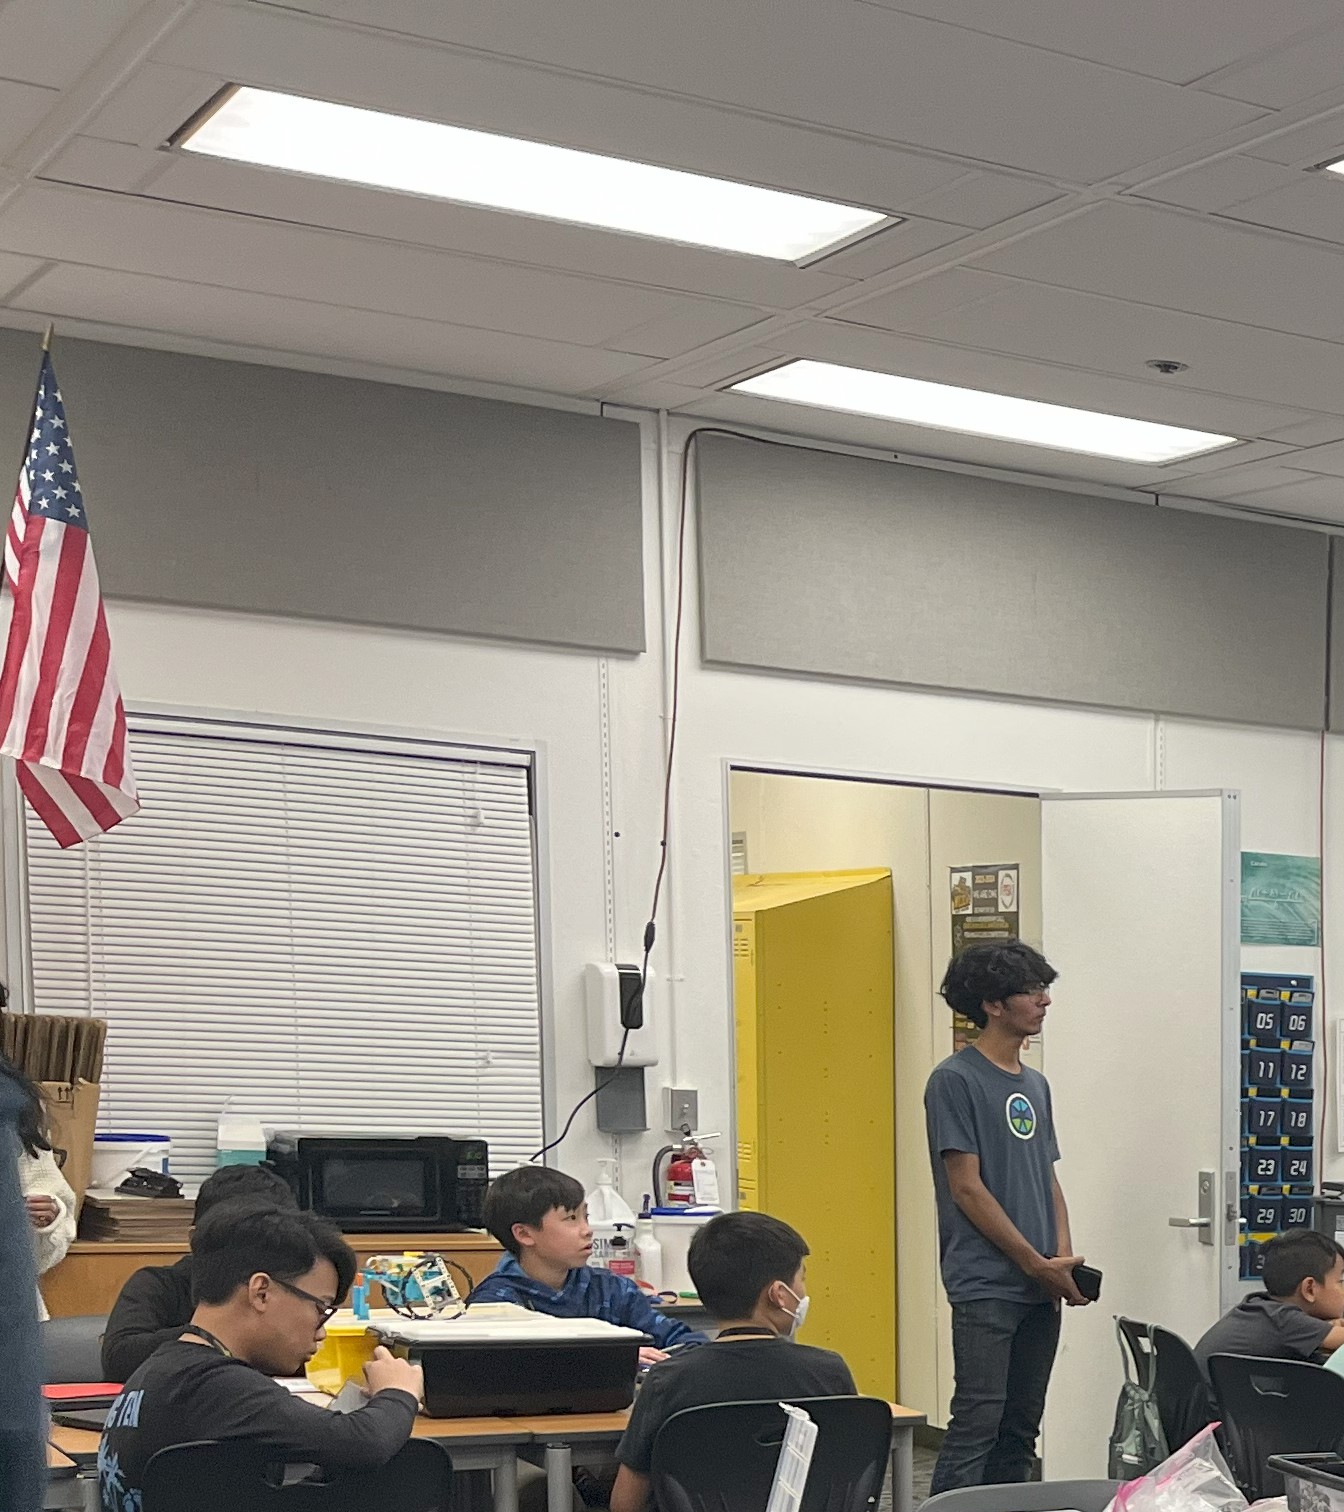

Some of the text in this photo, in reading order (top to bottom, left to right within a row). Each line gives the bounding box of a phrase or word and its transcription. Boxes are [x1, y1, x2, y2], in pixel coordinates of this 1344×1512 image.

[1256, 1012, 1275, 1030] 05
[1288, 1014, 1307, 1031] 06
[1257, 1061, 1275, 1079] 11
[1290, 1064, 1307, 1081] 12
[1258, 1110, 1276, 1127] 17
[1290, 1111, 1307, 1128] 18
[1257, 1158, 1276, 1176] 23
[1289, 1159, 1307, 1176] 24
[1256, 1207, 1275, 1224] 29
[1288, 1207, 1306, 1224] 30
